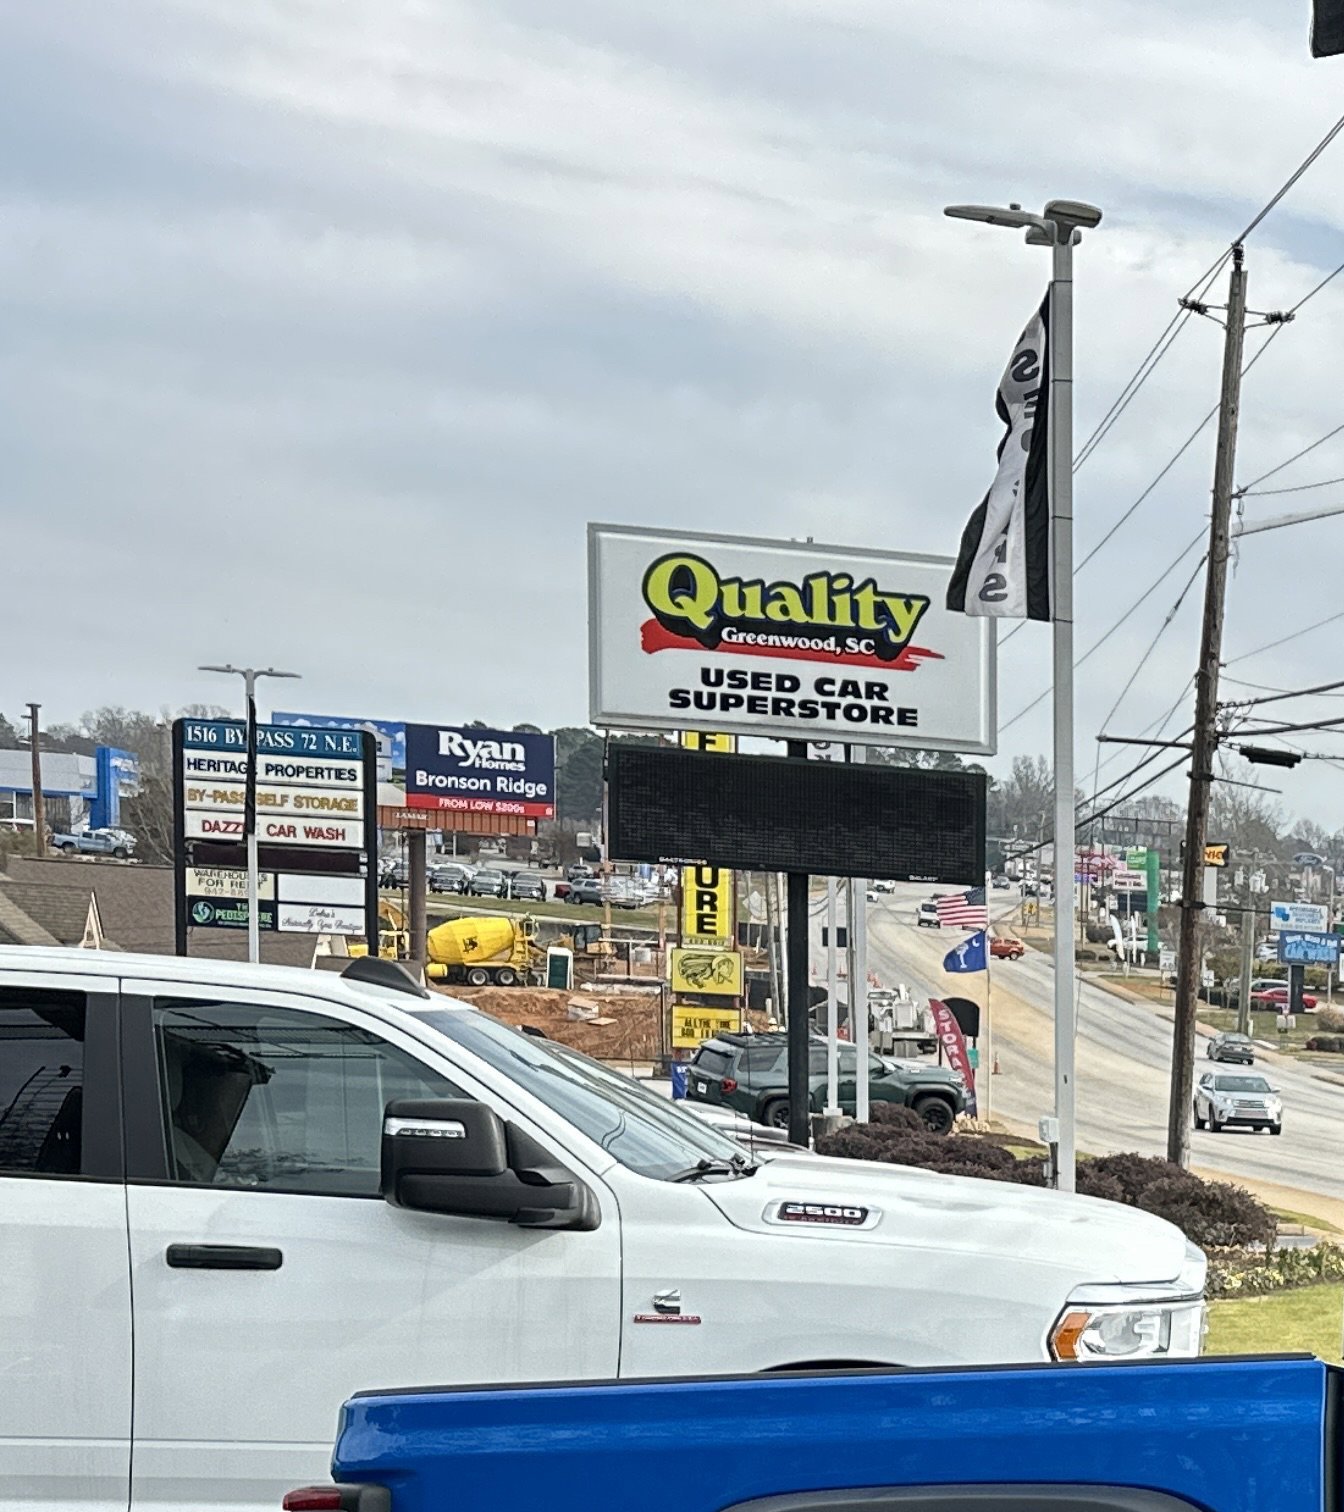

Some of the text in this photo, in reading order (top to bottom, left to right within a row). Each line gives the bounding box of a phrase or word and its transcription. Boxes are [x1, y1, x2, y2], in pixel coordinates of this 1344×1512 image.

[645, 555, 927, 644] Quality
[721, 627, 876, 654] Greenwood, SC
[700, 667, 889, 701] USED CAR
[668, 689, 918, 727] SUPERSTORE
[186, 725, 217, 743] 1516
[301, 733, 317, 751] 72
[324, 736, 358, 753] N.E.
[438, 730, 526, 767] Ryan
[187, 757, 357, 782] HERITAG PROPERTIES
[475, 756, 526, 771] Homes
[415, 770, 547, 798] Bronson Ridge
[257, 793, 289, 808] SELF
[293, 795, 358, 812] STORAGE
[438, 798, 469, 810] FROM
[470, 799, 494, 812] LOW
[202, 820, 346, 842] DAZZ CAR WASH
[786, 1205, 861, 1218] 2500
